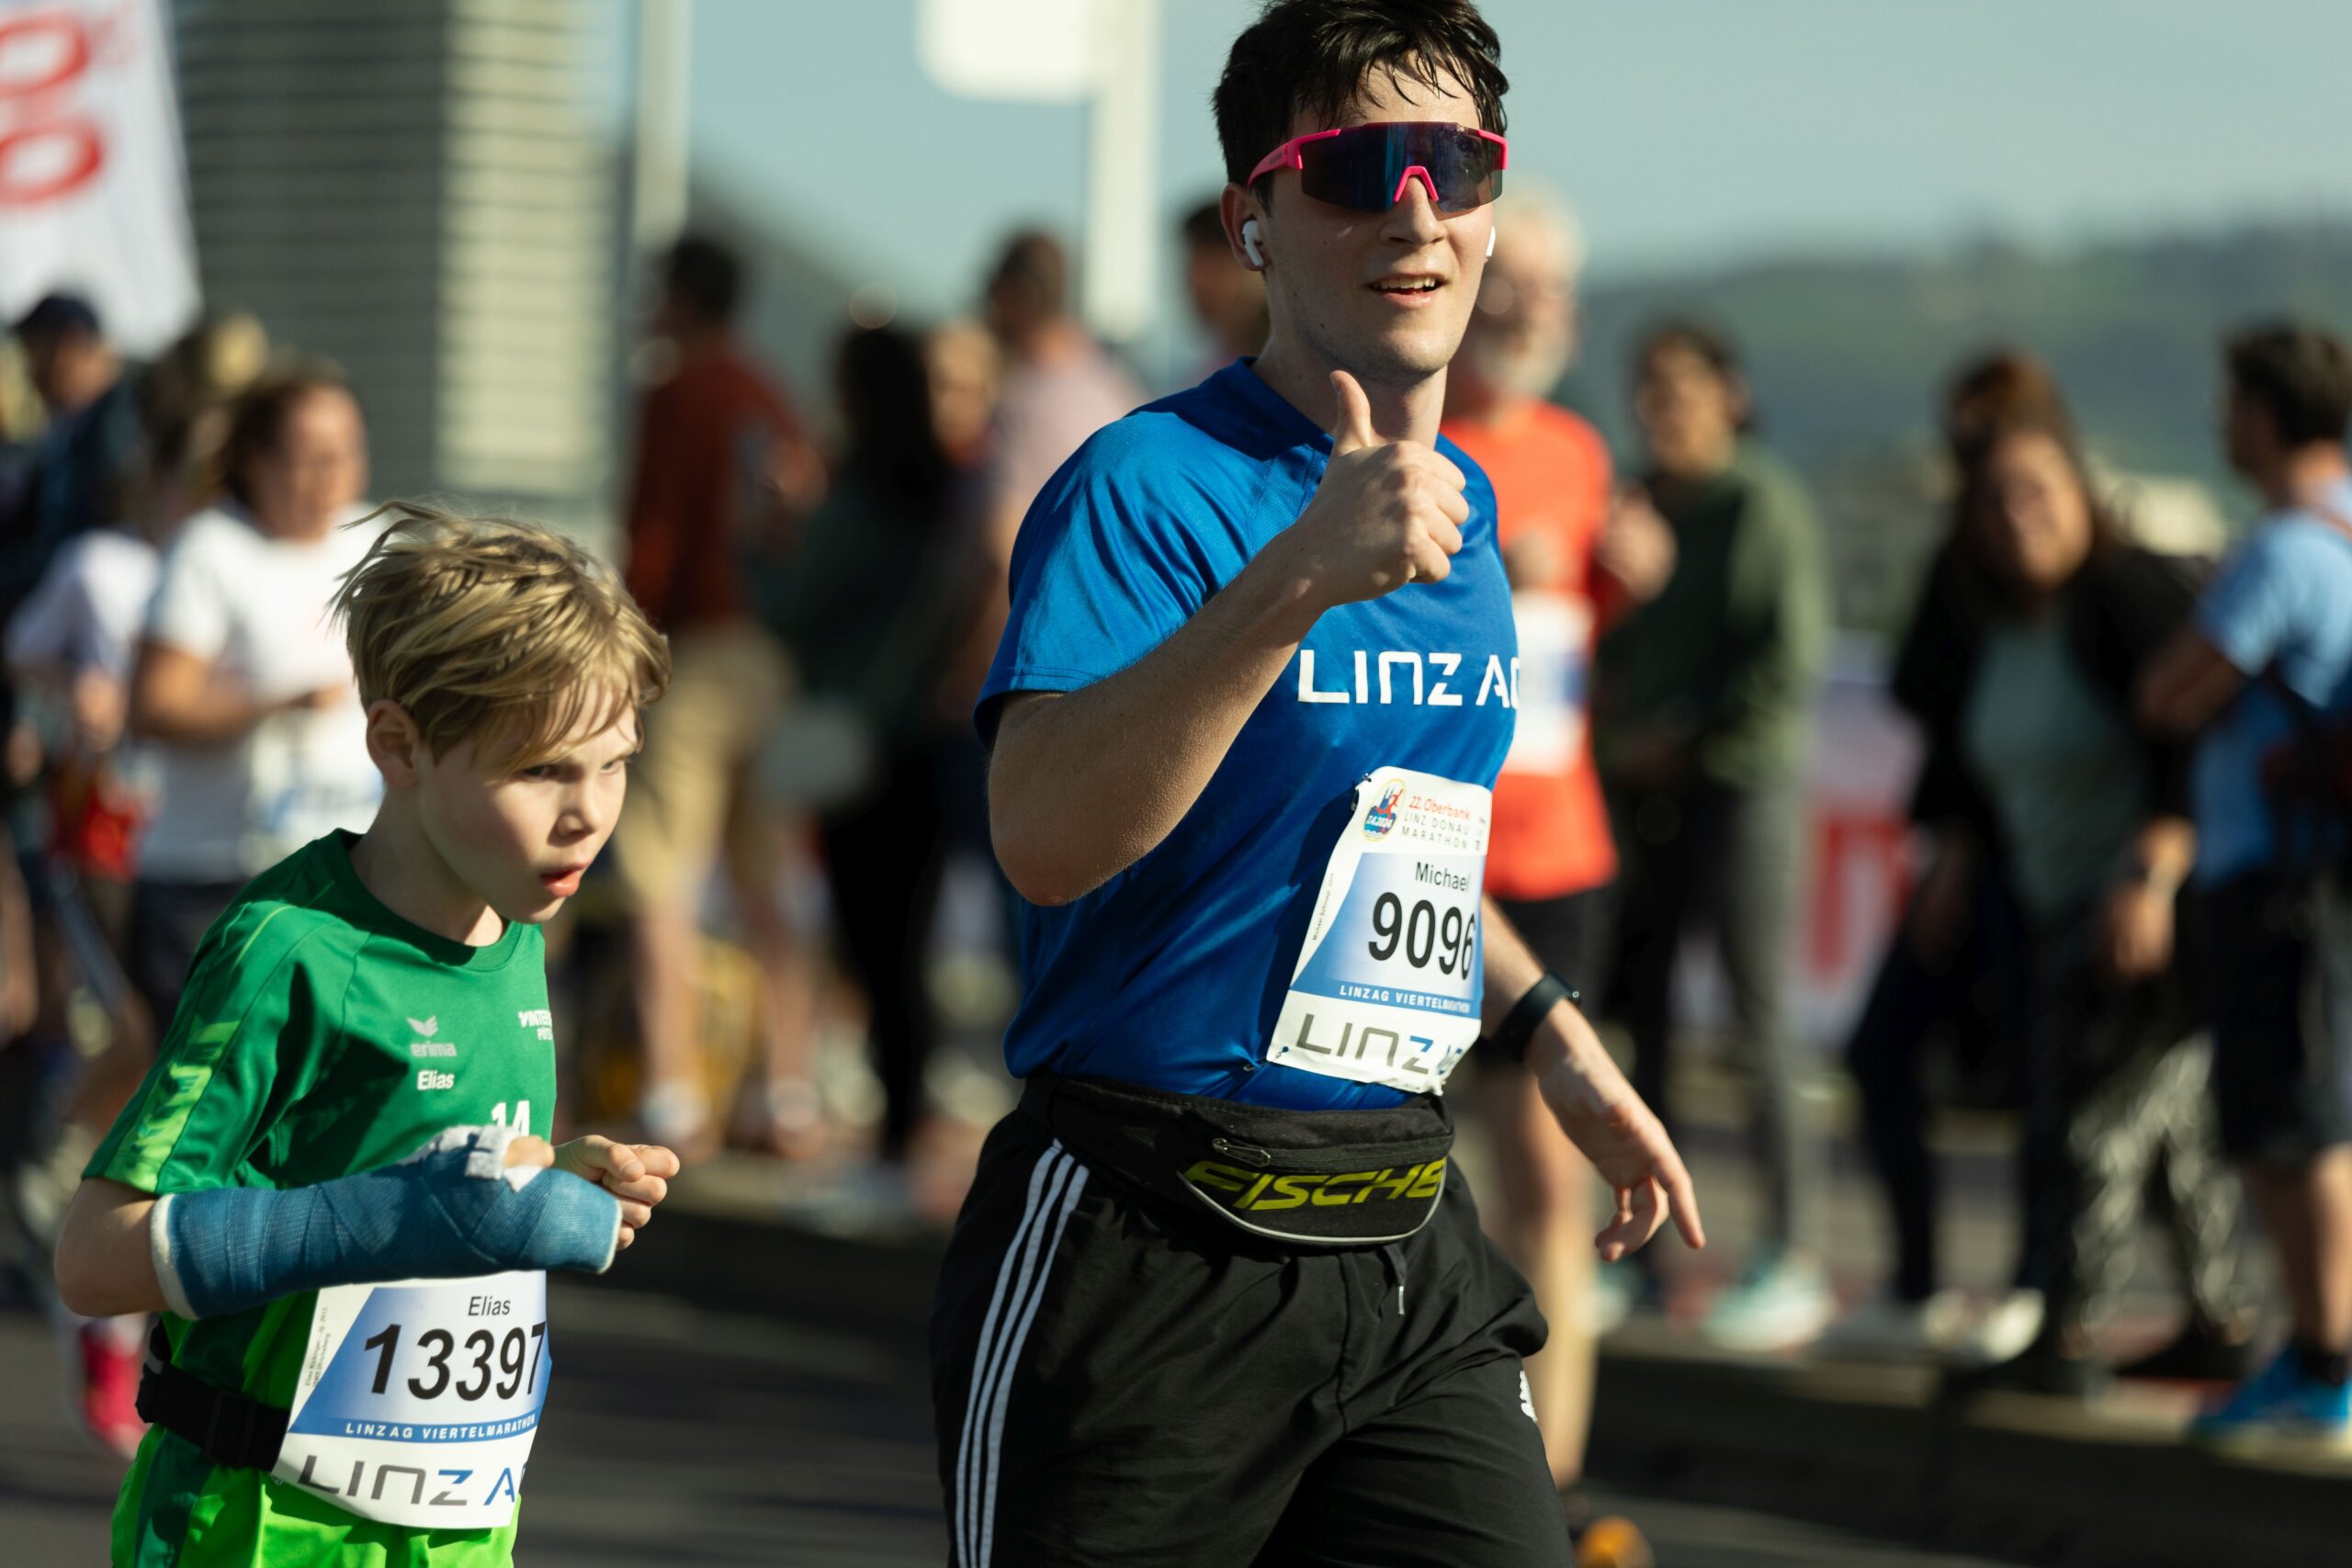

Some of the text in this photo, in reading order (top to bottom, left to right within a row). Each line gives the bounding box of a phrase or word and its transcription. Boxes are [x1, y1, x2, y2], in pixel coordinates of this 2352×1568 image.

[1476, 654, 1521, 709] A
[1401, 825, 1468, 850] MARATHON
[1368, 891, 1476, 980] 9096
[410, 1043, 458, 1057] erima
[416, 1069, 456, 1091] Elias
[491, 1100, 530, 1136] 14
[468, 1296, 512, 1317] Elias
[364, 1321, 548, 1402] 13397
[422, 1413, 536, 1440] VIERTELMARATHON
